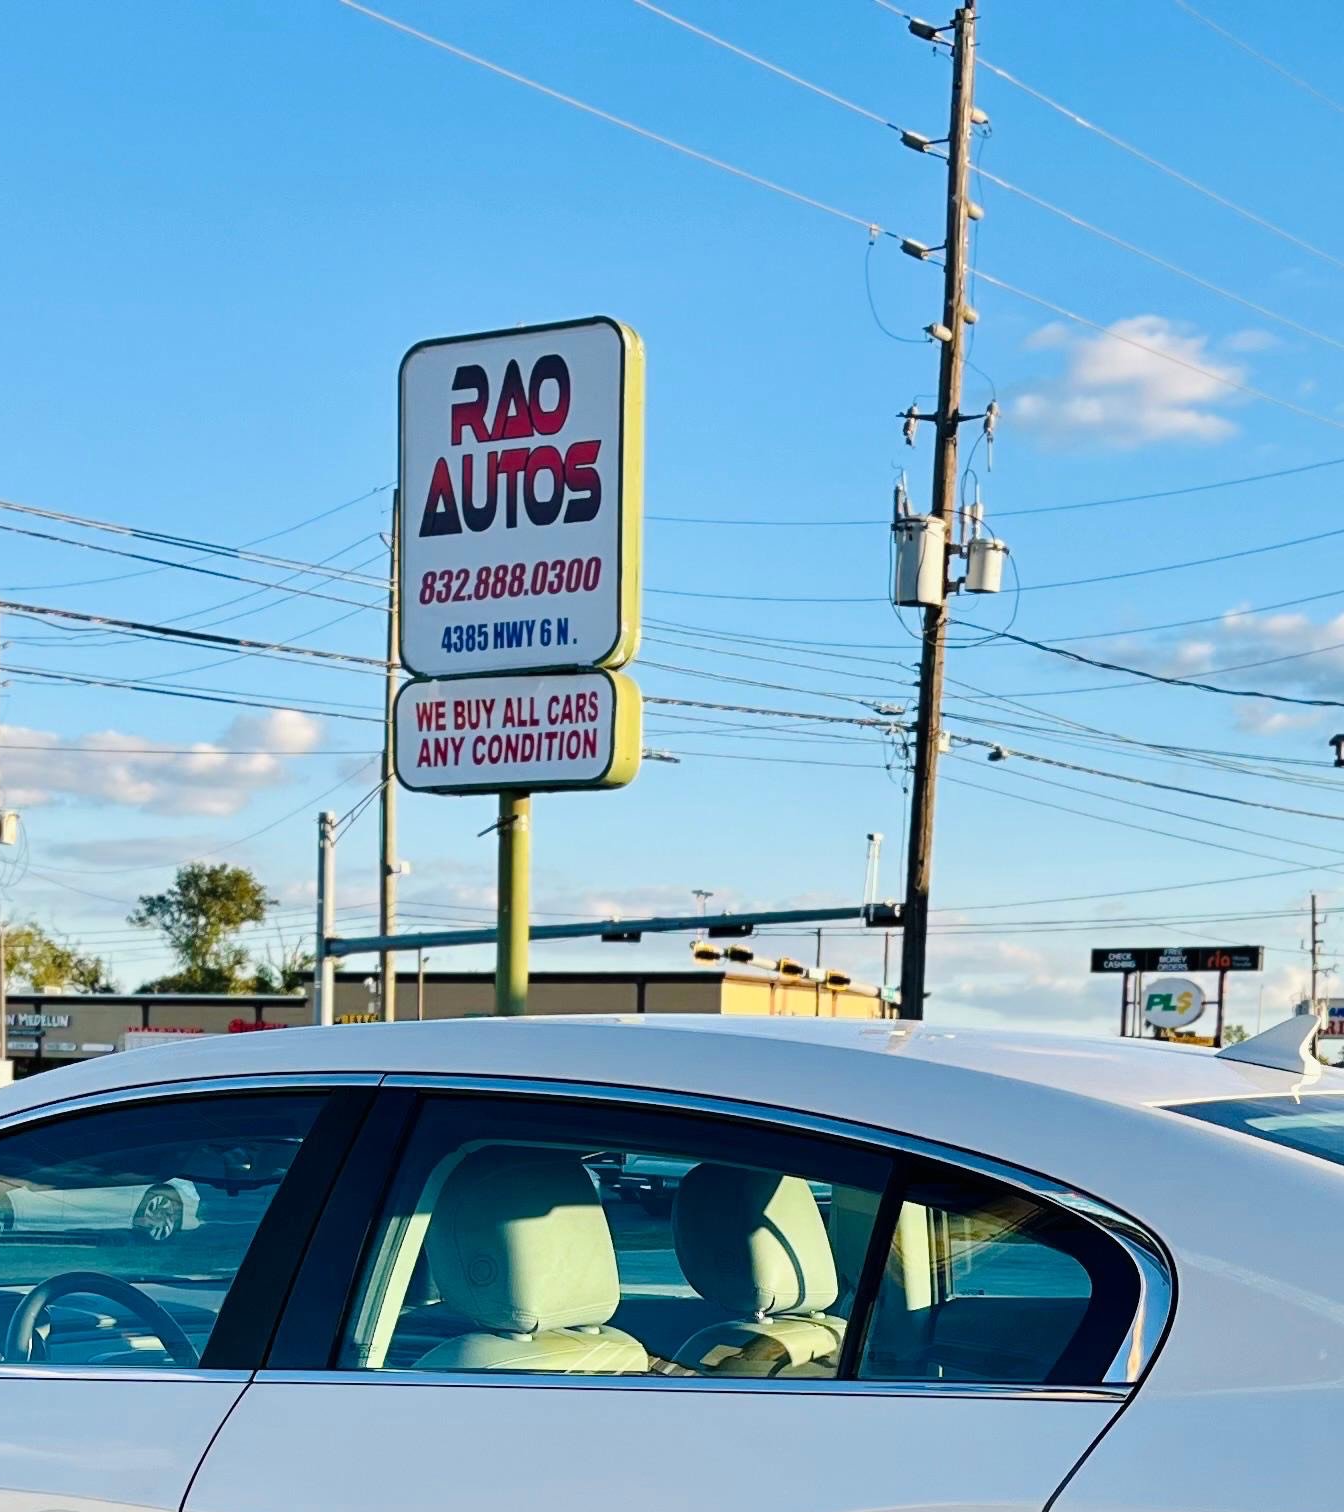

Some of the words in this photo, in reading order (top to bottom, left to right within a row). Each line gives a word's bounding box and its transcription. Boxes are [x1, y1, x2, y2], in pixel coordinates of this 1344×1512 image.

[451, 354, 570, 446] RAO
[419, 440, 602, 538] AUTOS
[419, 556, 602, 606] 832.888.0300
[441, 624, 488, 653] 4385
[493, 619, 536, 649] HWY
[540, 618, 552, 647] 6
[416, 701, 446, 732] WE
[453, 698, 496, 731] BUY
[502, 697, 540, 729] ALL
[547, 691, 599, 726] CARS
[416, 736, 465, 768] ANY
[472, 728, 598, 766] CONDITION
[1103, 961, 1136, 969] CASHING
[1157, 963, 1188, 971] ORDERS
